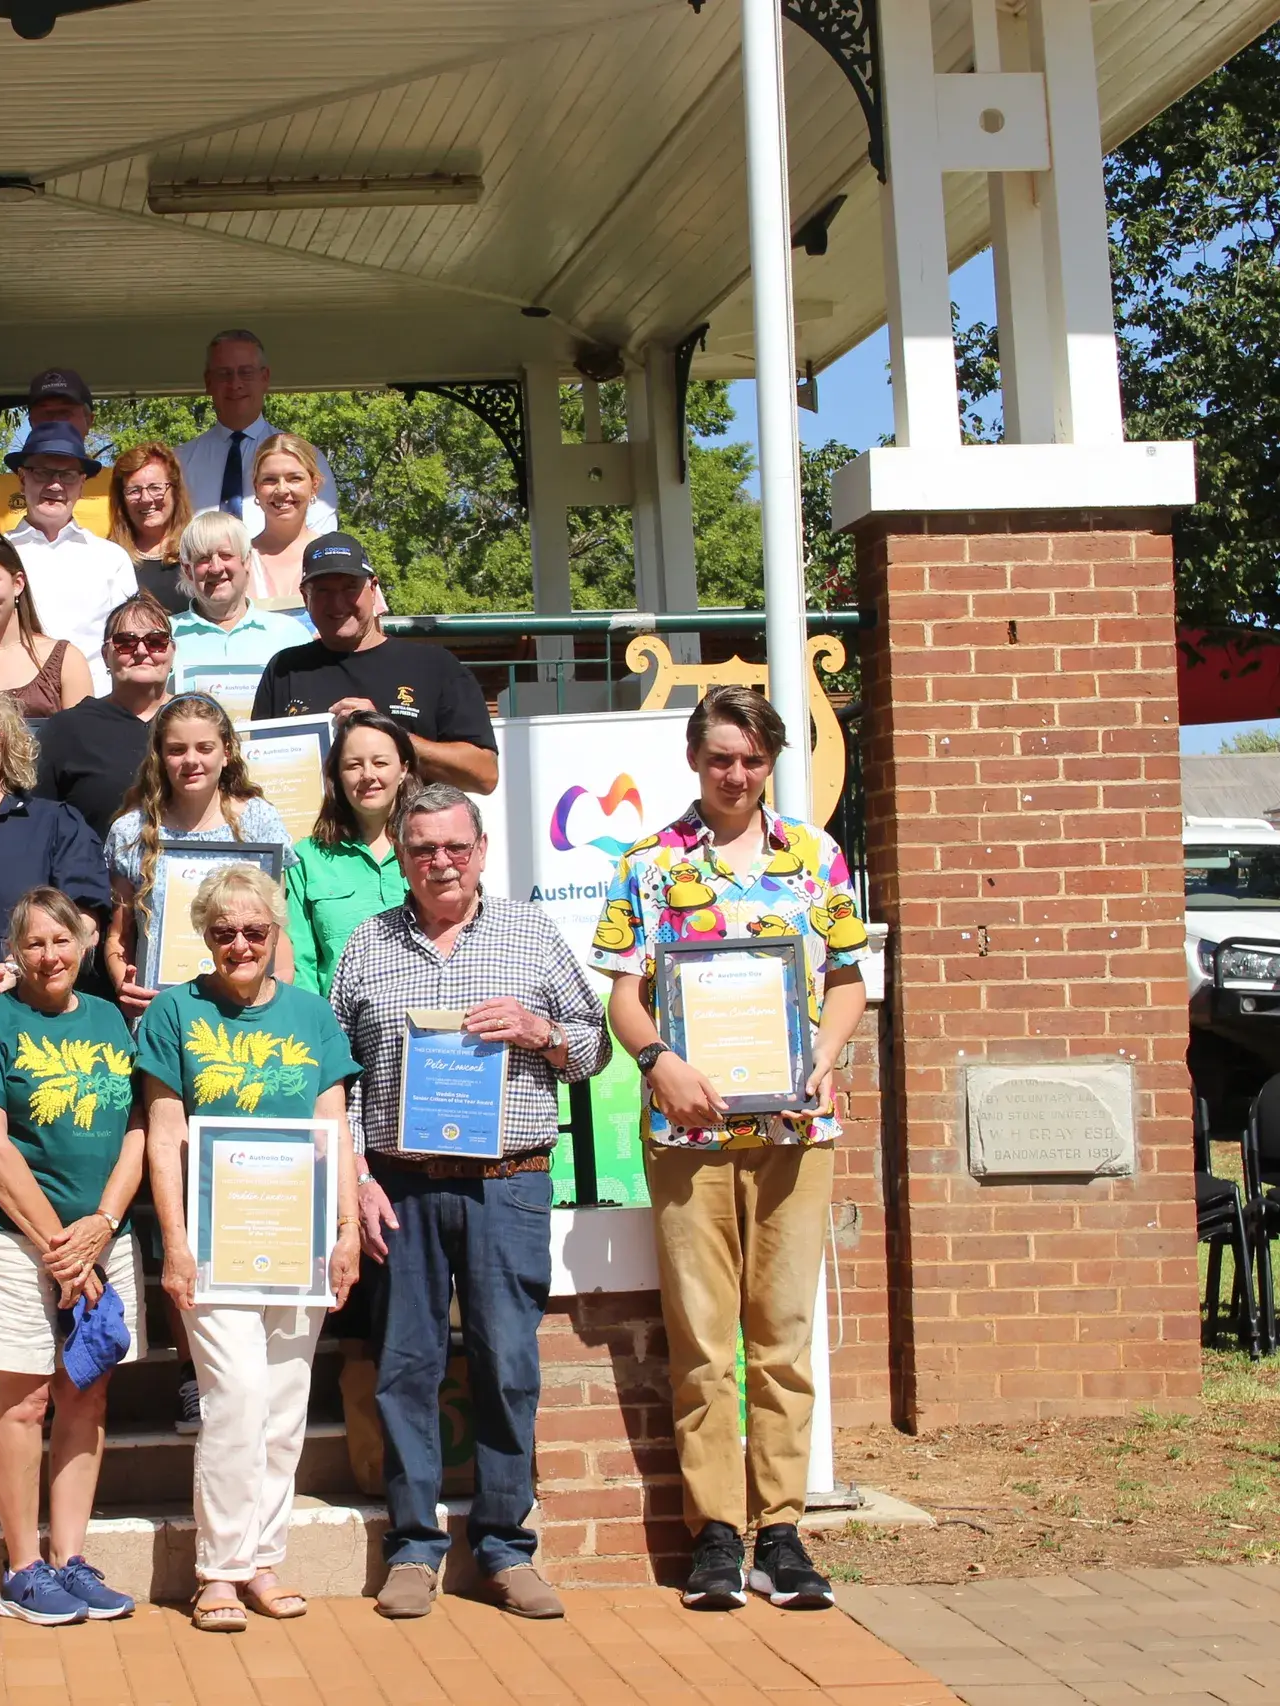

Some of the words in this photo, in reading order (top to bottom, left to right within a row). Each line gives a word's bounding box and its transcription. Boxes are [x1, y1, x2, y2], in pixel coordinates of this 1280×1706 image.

[529, 881, 608, 902] Australi
[424, 1058, 448, 1070] Peter
[448, 1060, 486, 1072] Lowcock
[1006, 1093, 1071, 1103] VOLUNTARY
[981, 1111, 1003, 1120] AND
[1008, 1111, 1045, 1120] STONE
[1052, 1110, 1106, 1119] UNVEILED
[1029, 1128, 1076, 1140] GRAY
[995, 1149, 1081, 1160] BANDMASTER
